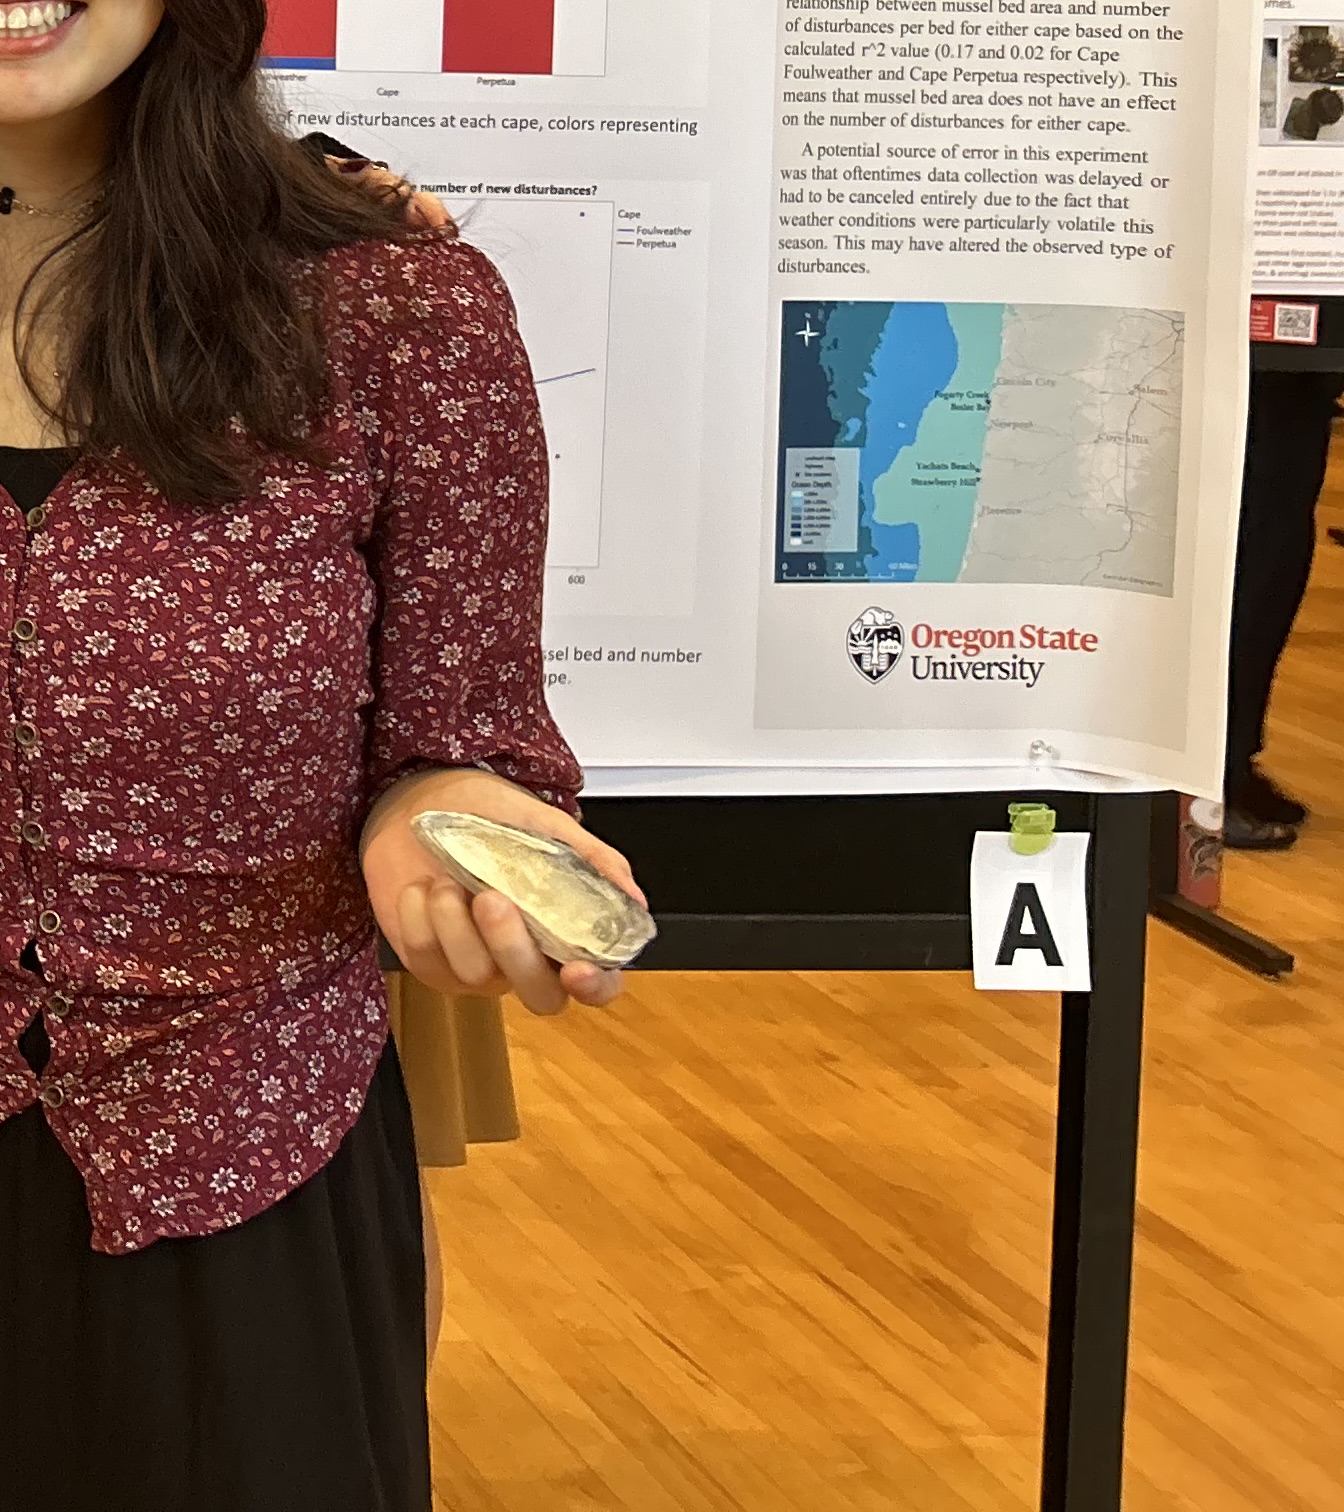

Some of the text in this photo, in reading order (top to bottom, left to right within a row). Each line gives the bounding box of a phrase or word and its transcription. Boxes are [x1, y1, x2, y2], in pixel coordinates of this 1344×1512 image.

[297, 110, 698, 136] new disturbances at each cape, colors representing
[420, 182, 597, 196] number of new disturbances?
[618, 209, 641, 220] Cape
[636, 225, 692, 236] Foulweather
[636, 238, 677, 250] Perpetua
[911, 623, 1098, 657] Oregon State
[573, 646, 702, 663] bed and number
[911, 655, 1045, 688] University
[994, 882, 1064, 967] A
